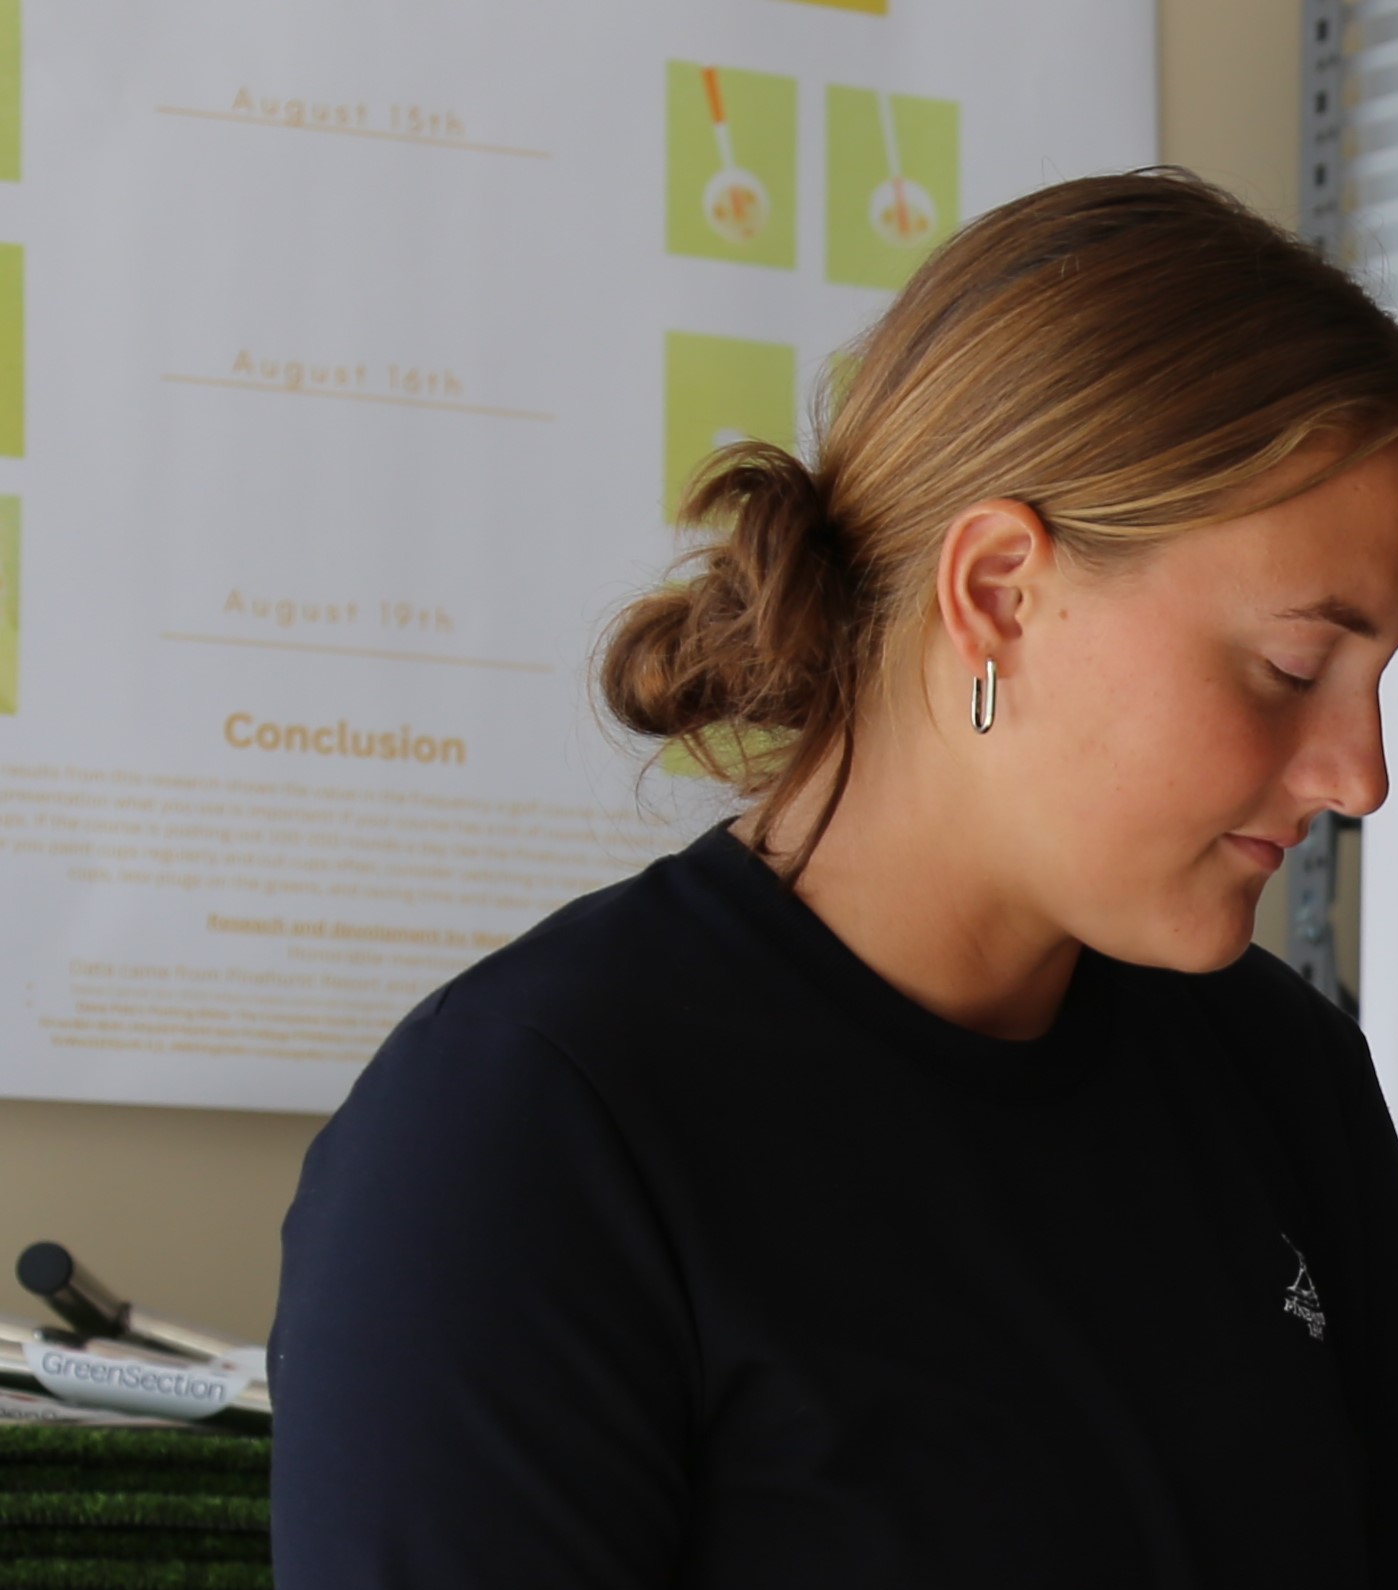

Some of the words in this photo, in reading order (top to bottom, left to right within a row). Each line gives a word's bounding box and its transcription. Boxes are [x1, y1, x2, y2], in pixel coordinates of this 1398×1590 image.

[232, 86, 368, 127] August
[390, 102, 466, 135] 15th
[232, 349, 368, 391] August
[389, 363, 464, 395] 16th
[223, 588, 359, 628] August
[380, 600, 455, 632] 19th
[223, 711, 467, 765] Conclusion
[42, 1350, 226, 1402] GreenSection
